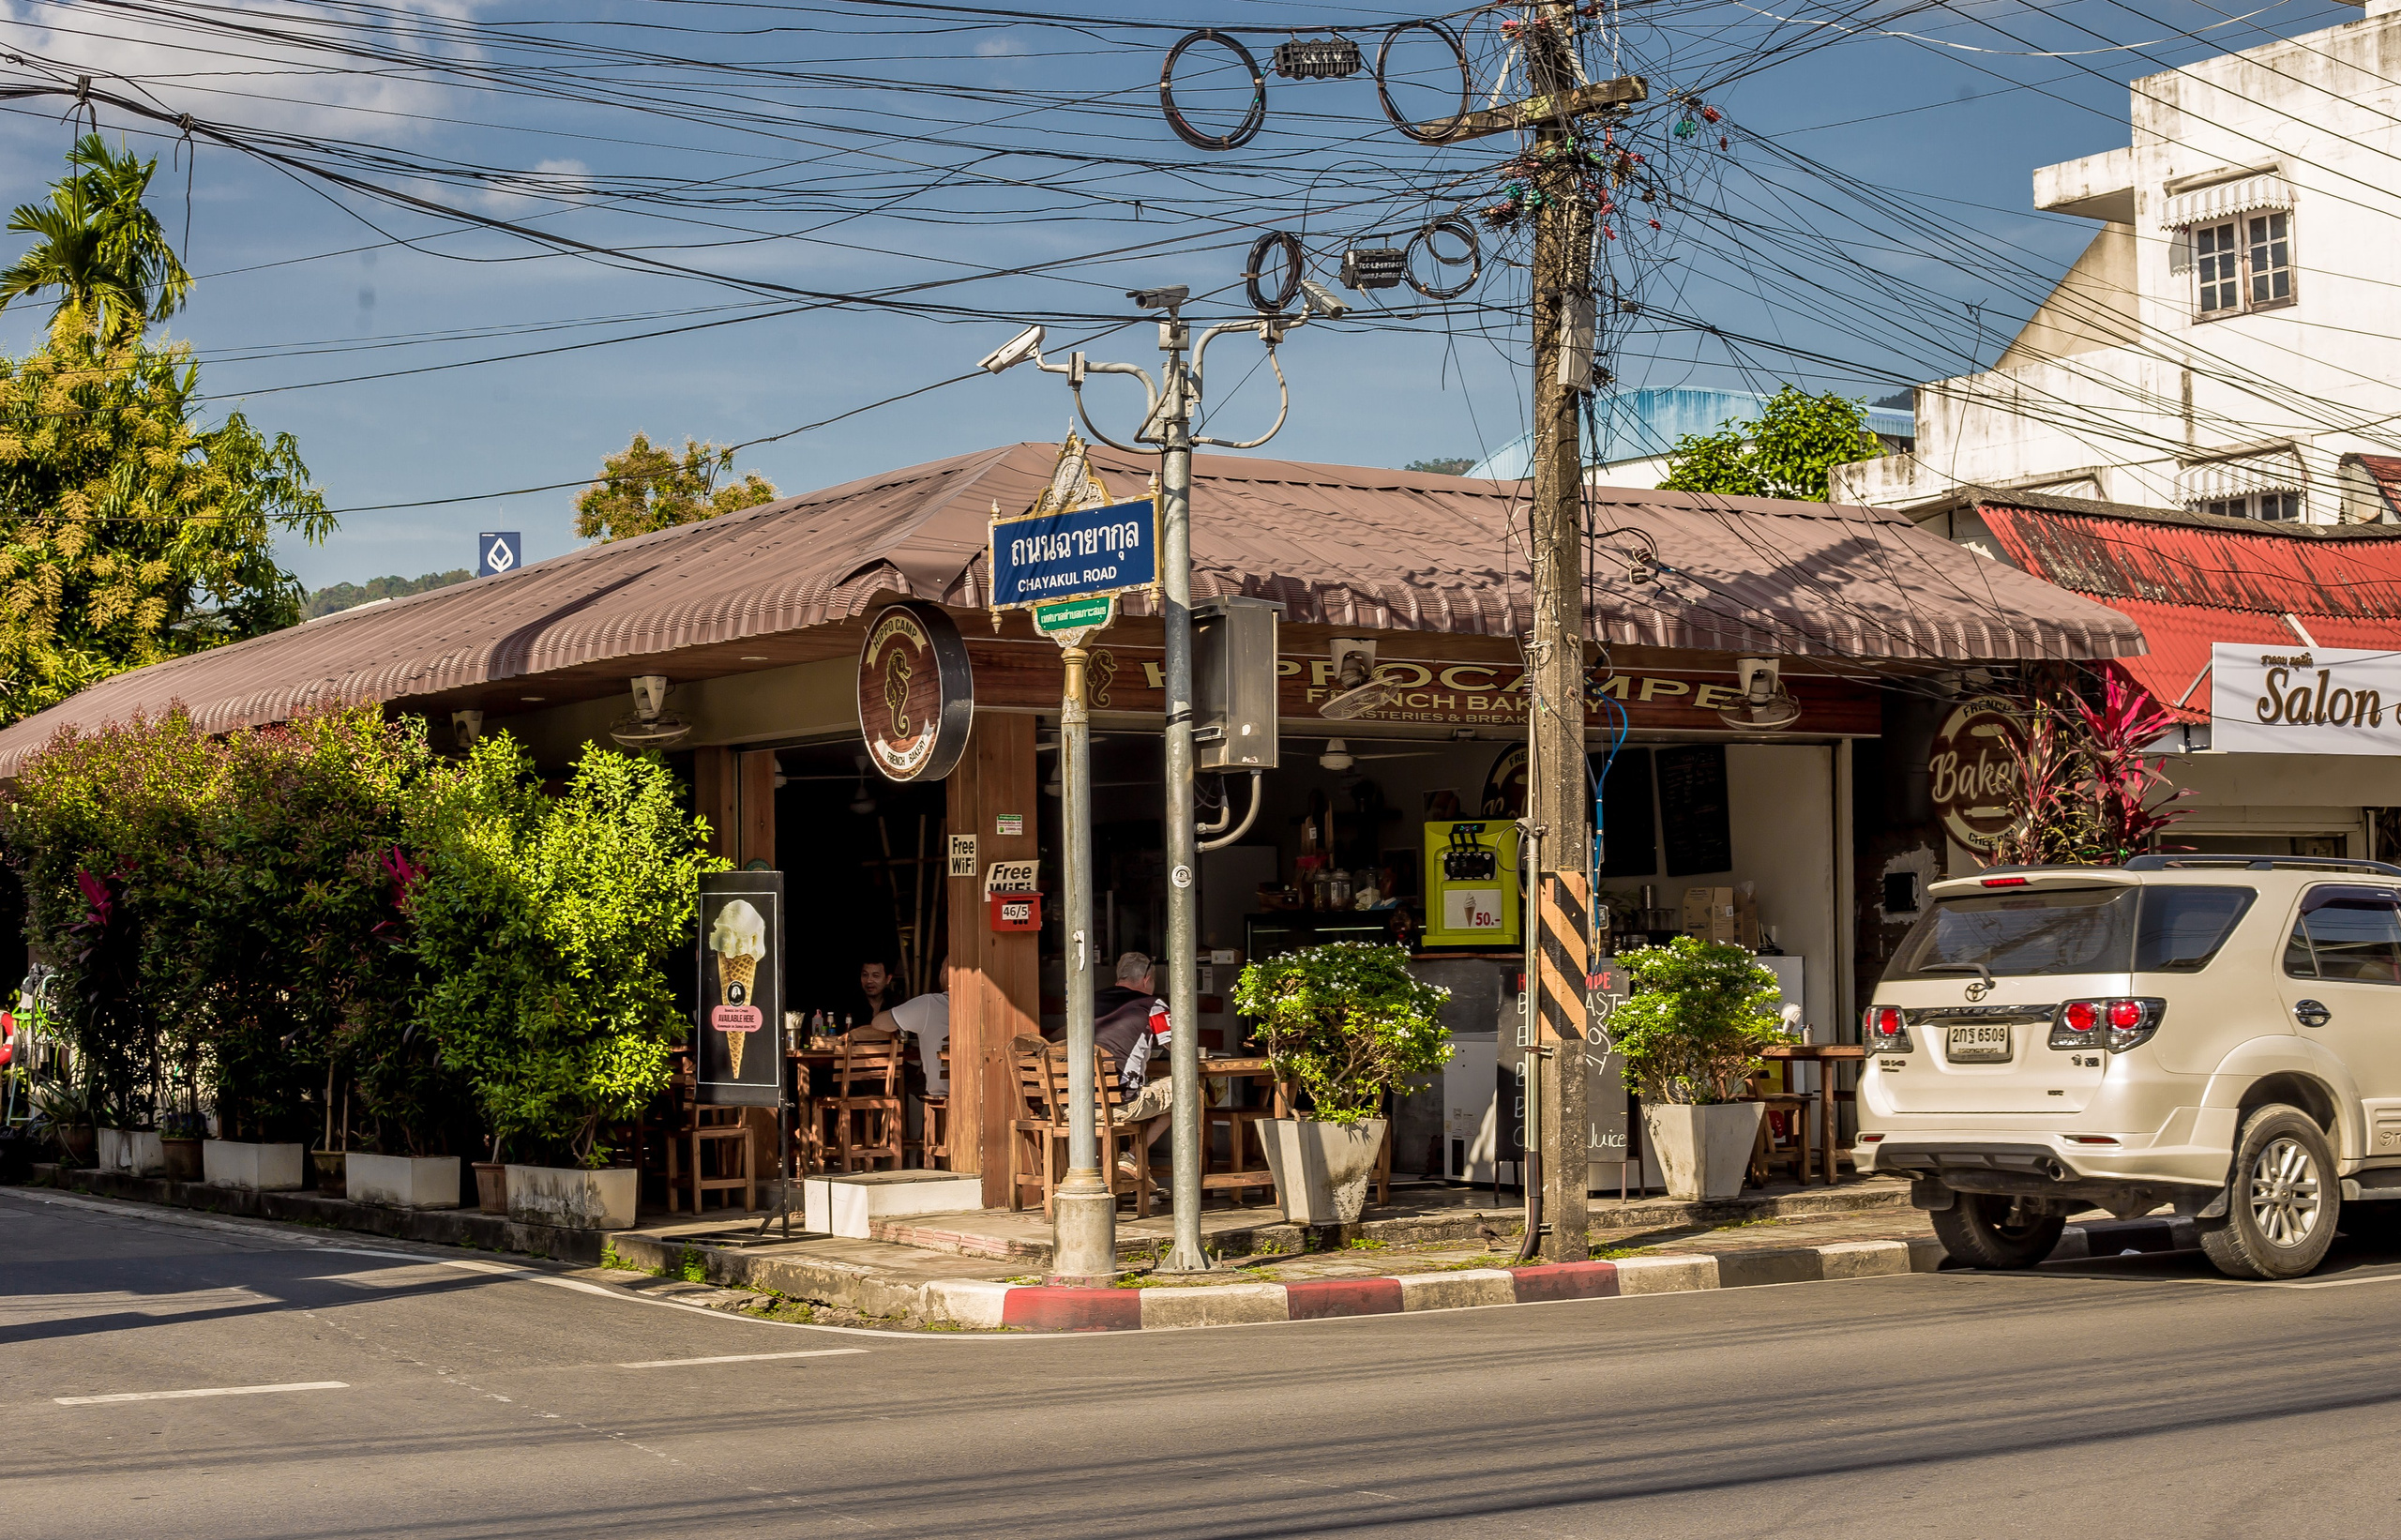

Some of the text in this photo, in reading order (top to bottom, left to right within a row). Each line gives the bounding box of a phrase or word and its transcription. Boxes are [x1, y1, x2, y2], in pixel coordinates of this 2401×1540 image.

[1011, 521, 1140, 566] ถนนฉายากุล
[1018, 566, 1117, 593] CHAYAKUL ROAD
[872, 619, 918, 650] HIPPO CAMP
[1467, 694, 1605, 714] BAKY
[2256, 667, 2382, 728] Salon
[1448, 714, 1461, 722] &
[1463, 714, 1529, 724] BREAK
[886, 737, 926, 767] FRENCH BAKERY
[1508, 751, 1527, 767] FRE
[952, 837, 974, 854] Free
[952, 857, 974, 874] WiFi
[992, 864, 1033, 880] Free
[1003, 905, 1028, 918] 46/5
[1475, 912, 1501, 927] 50.-
[717, 1014, 755, 1023] AVAILABLE HERE
[1977, 1027, 2006, 1043] 6509
[1587, 1122, 1627, 1150] Juice
